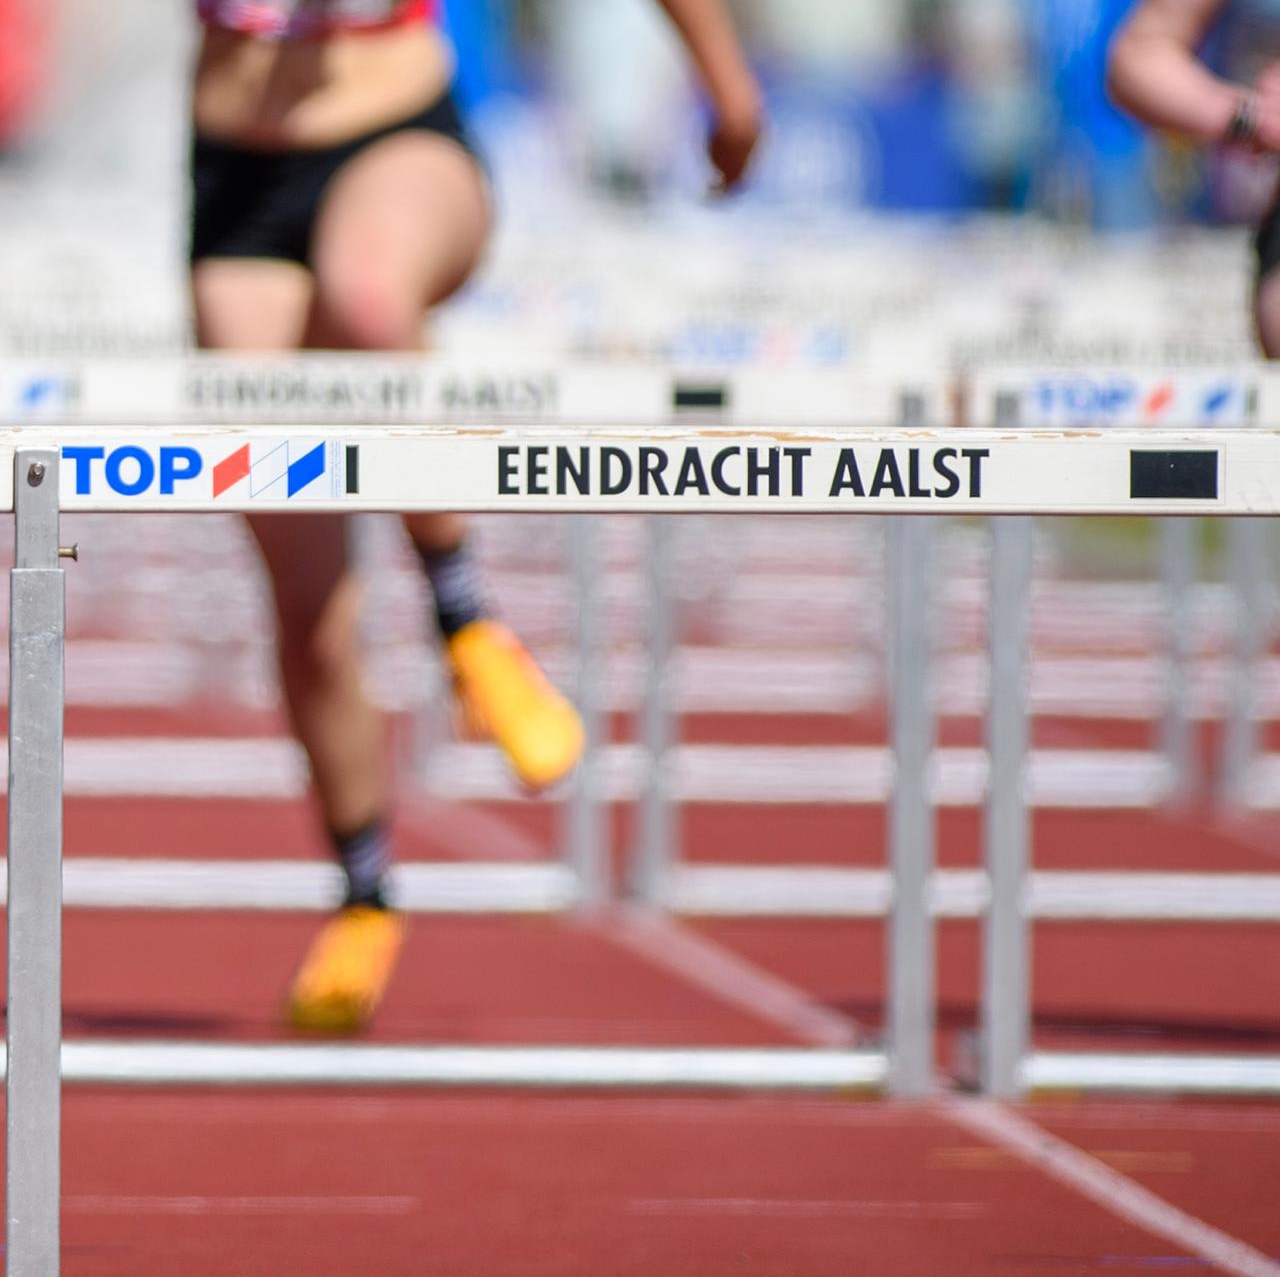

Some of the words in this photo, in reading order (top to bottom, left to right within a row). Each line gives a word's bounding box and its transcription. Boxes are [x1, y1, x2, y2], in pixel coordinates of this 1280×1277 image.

[62, 446, 203, 495] TOP
[498, 447, 811, 496] EENDRACHT
[829, 448, 990, 498] AALST
